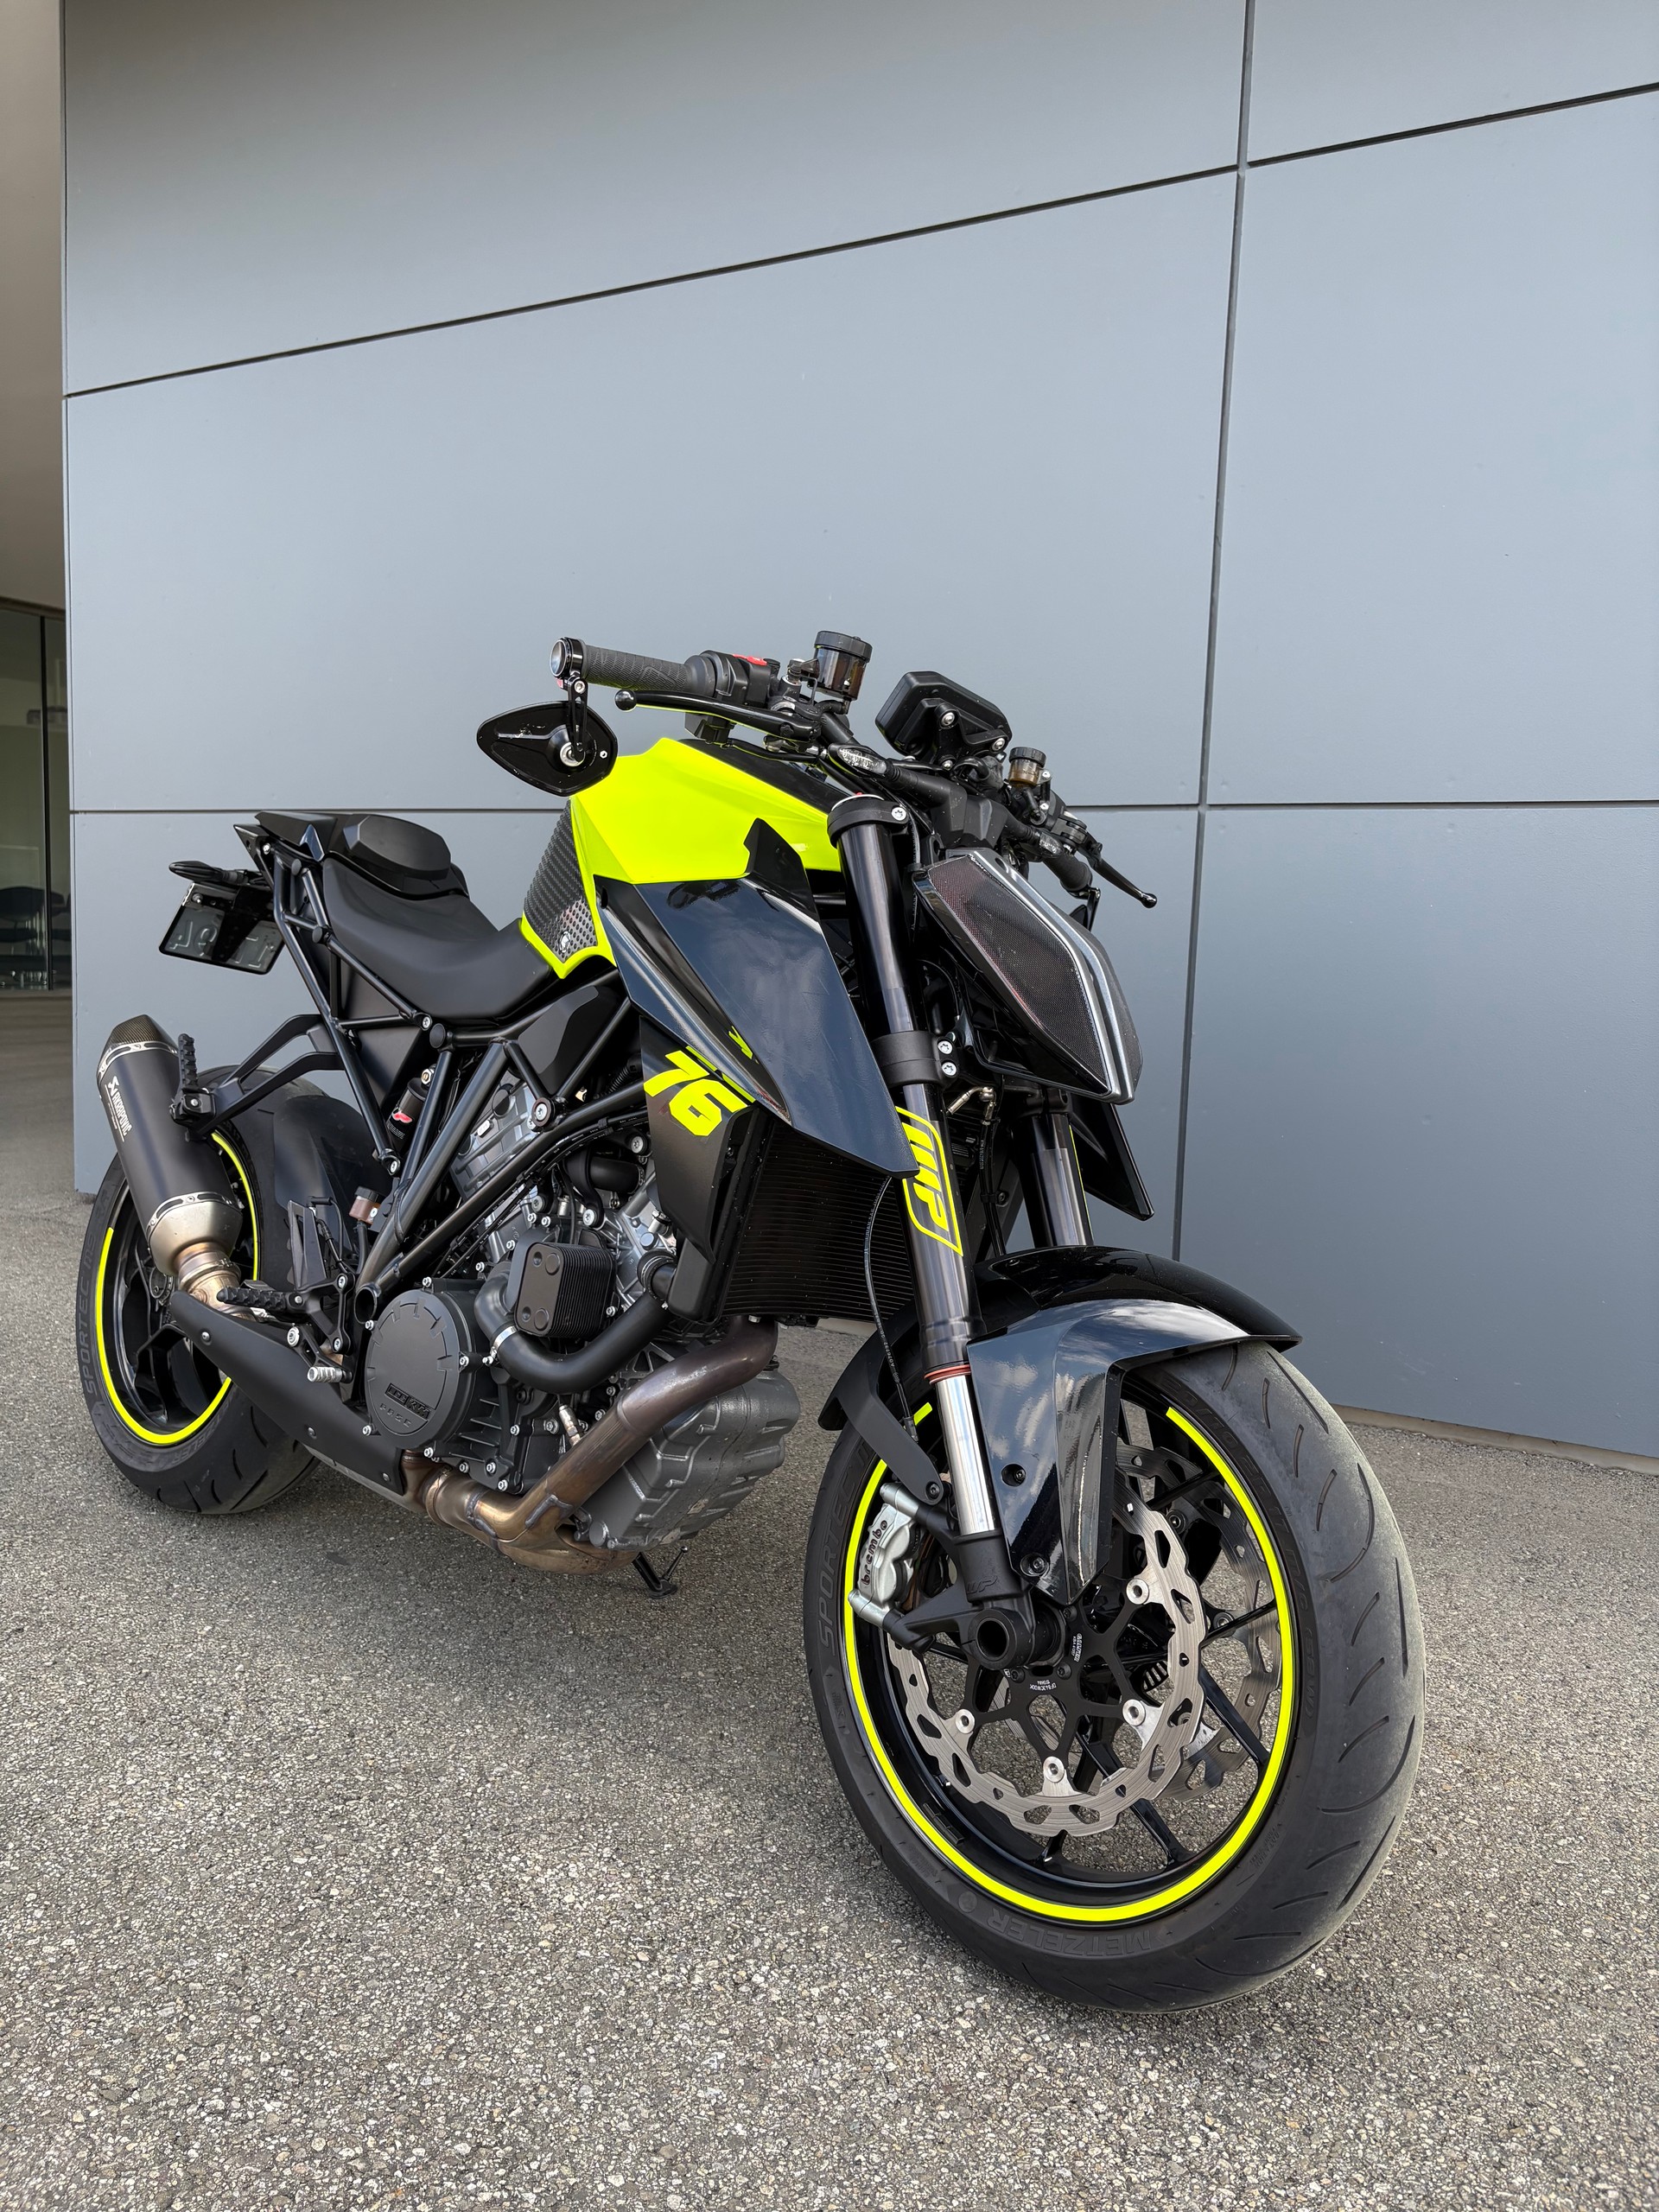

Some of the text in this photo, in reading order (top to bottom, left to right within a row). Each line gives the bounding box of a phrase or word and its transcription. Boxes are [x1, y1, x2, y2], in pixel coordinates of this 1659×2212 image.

[643, 1050, 748, 1137] 76
[79, 1275, 96, 1396] SPORTEC
[819, 1471, 855, 1651] SPORTEC
[861, 1520, 888, 1586] brembo
[988, 1907, 1152, 1955] METZELER
